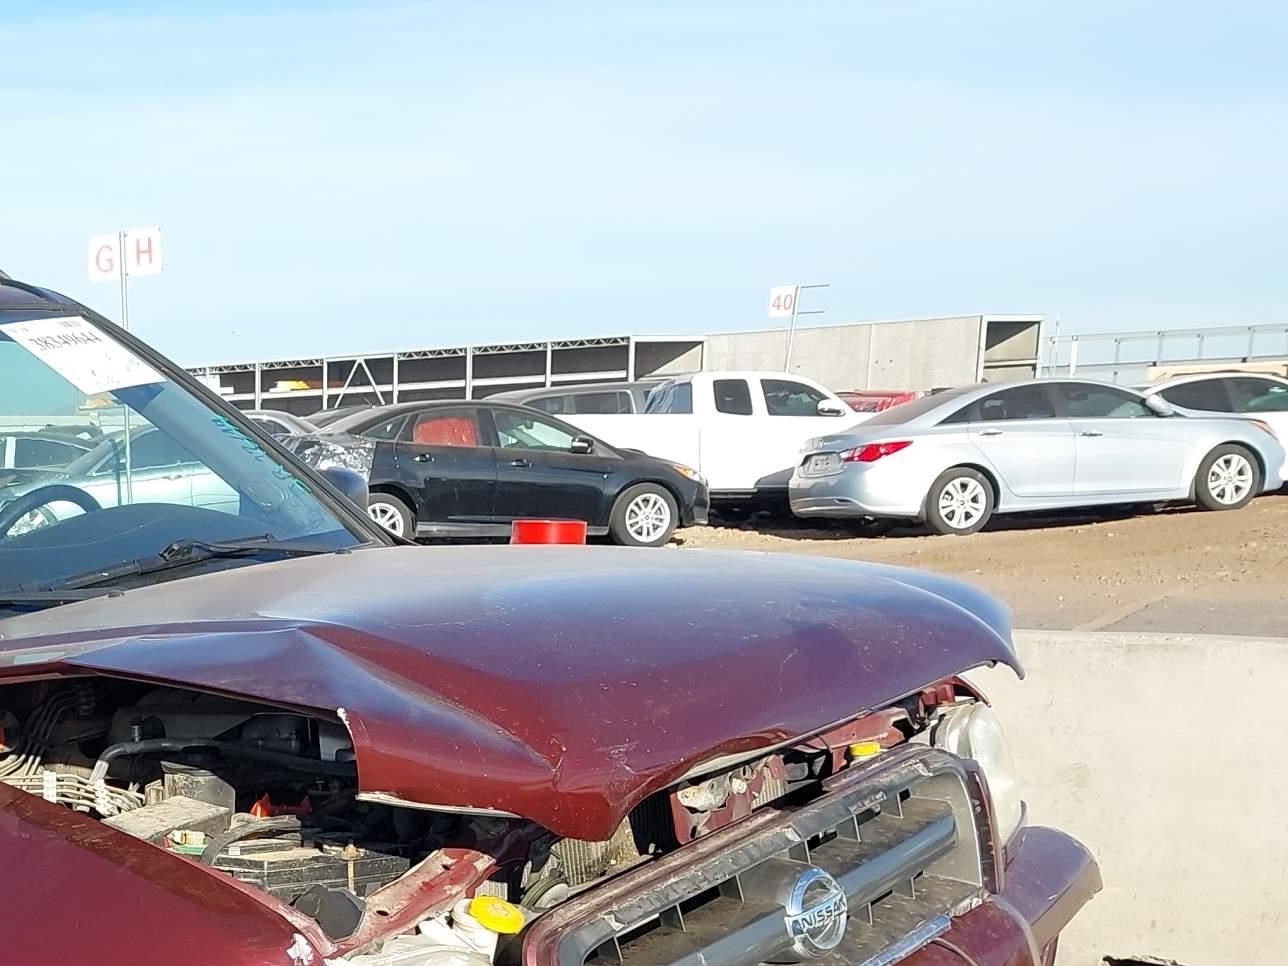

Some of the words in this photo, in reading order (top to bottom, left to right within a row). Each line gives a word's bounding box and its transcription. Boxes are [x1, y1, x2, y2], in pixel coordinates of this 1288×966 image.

[96, 244, 113, 273] G
[136, 236, 152, 266] H
[772, 294, 792, 311] 40
[28, 331, 103, 351] 38349644
